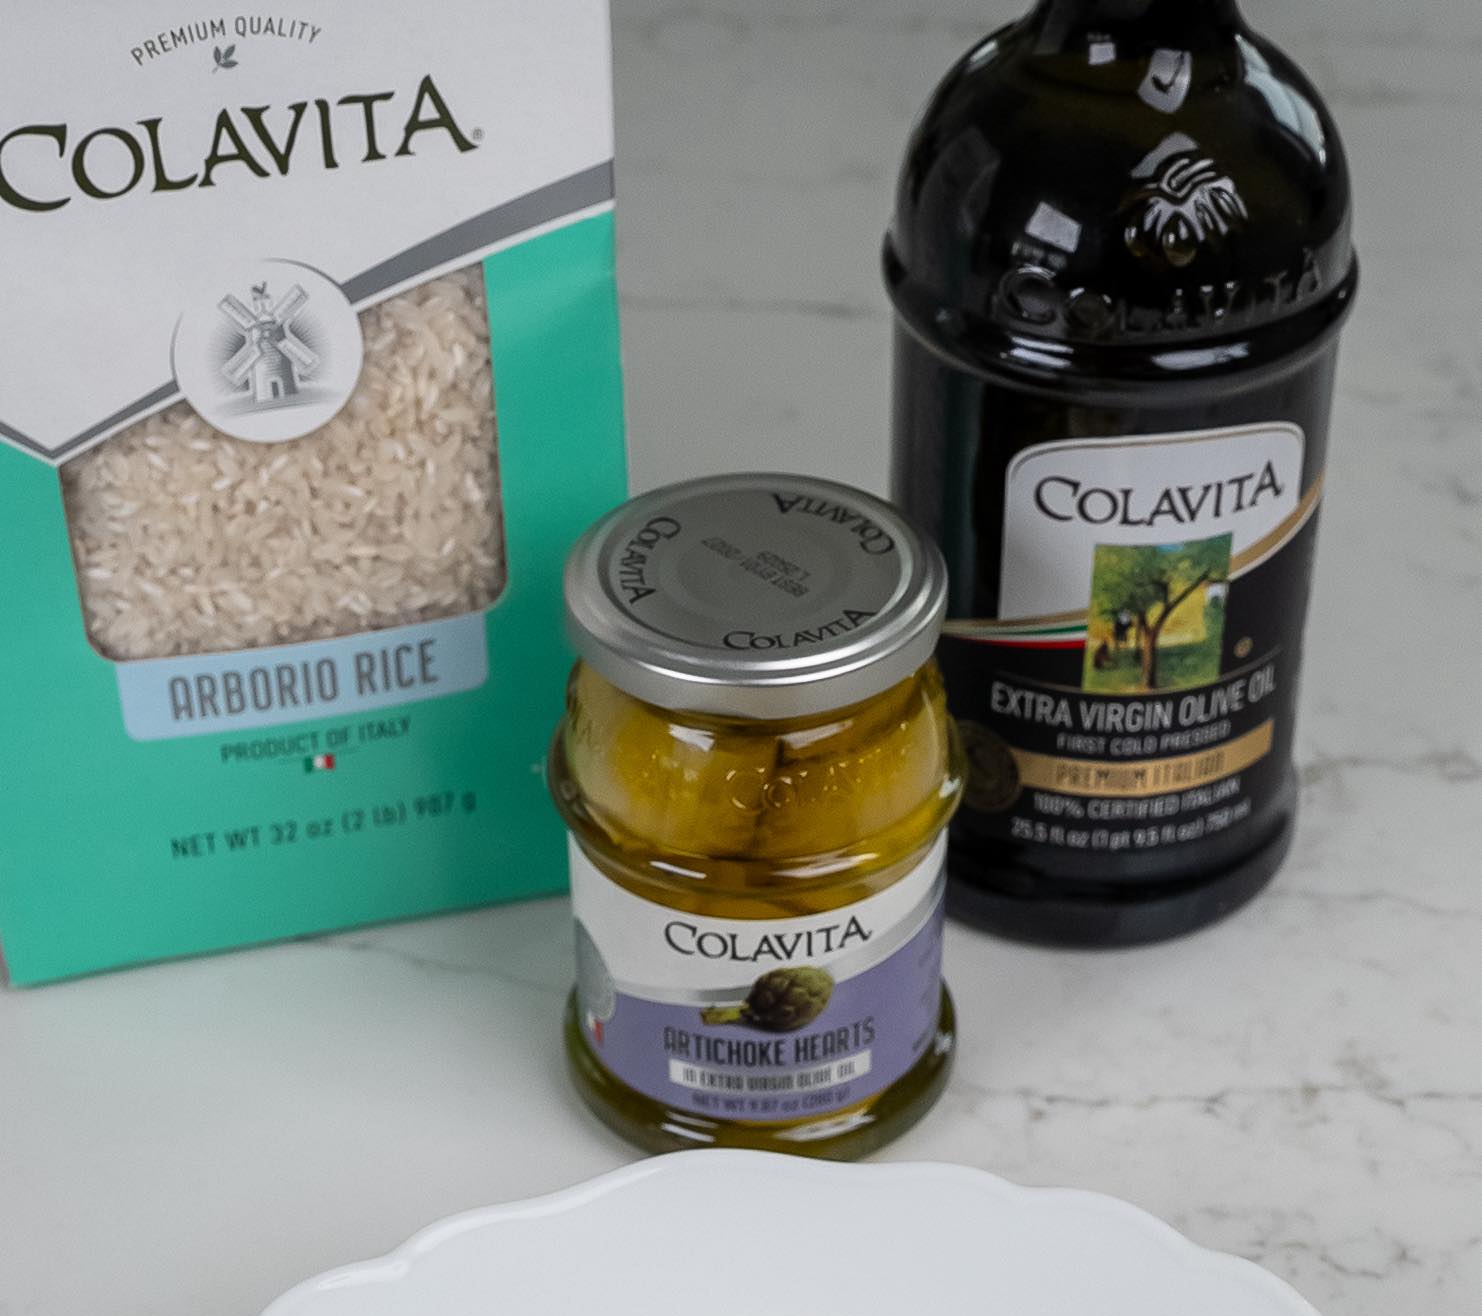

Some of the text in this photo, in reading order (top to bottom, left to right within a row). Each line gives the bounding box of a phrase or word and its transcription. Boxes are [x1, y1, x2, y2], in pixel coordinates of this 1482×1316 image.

[130, 16, 321, 66] PREMIUM QUALITY
[1034, 460, 1286, 526] COLAVITA
[773, 492, 895, 556] COLAVITA
[618, 516, 682, 605] COLAVITA
[722, 607, 877, 652] COLAVITA
[169, 638, 439, 721] ARBORIO RICE
[990, 665, 1276, 733] EXTRA VIRGIN OLIVE OIL
[220, 716, 411, 763] PRODUCT OF ITALY
[170, 831, 216, 858] NET
[225, 826, 261, 851] WT
[270, 820, 298, 845] 32
[306, 817, 334, 839] oz
[664, 915, 873, 962] COLAVITA
[663, 1016, 875, 1067] ARTICHOKE HEARTS
